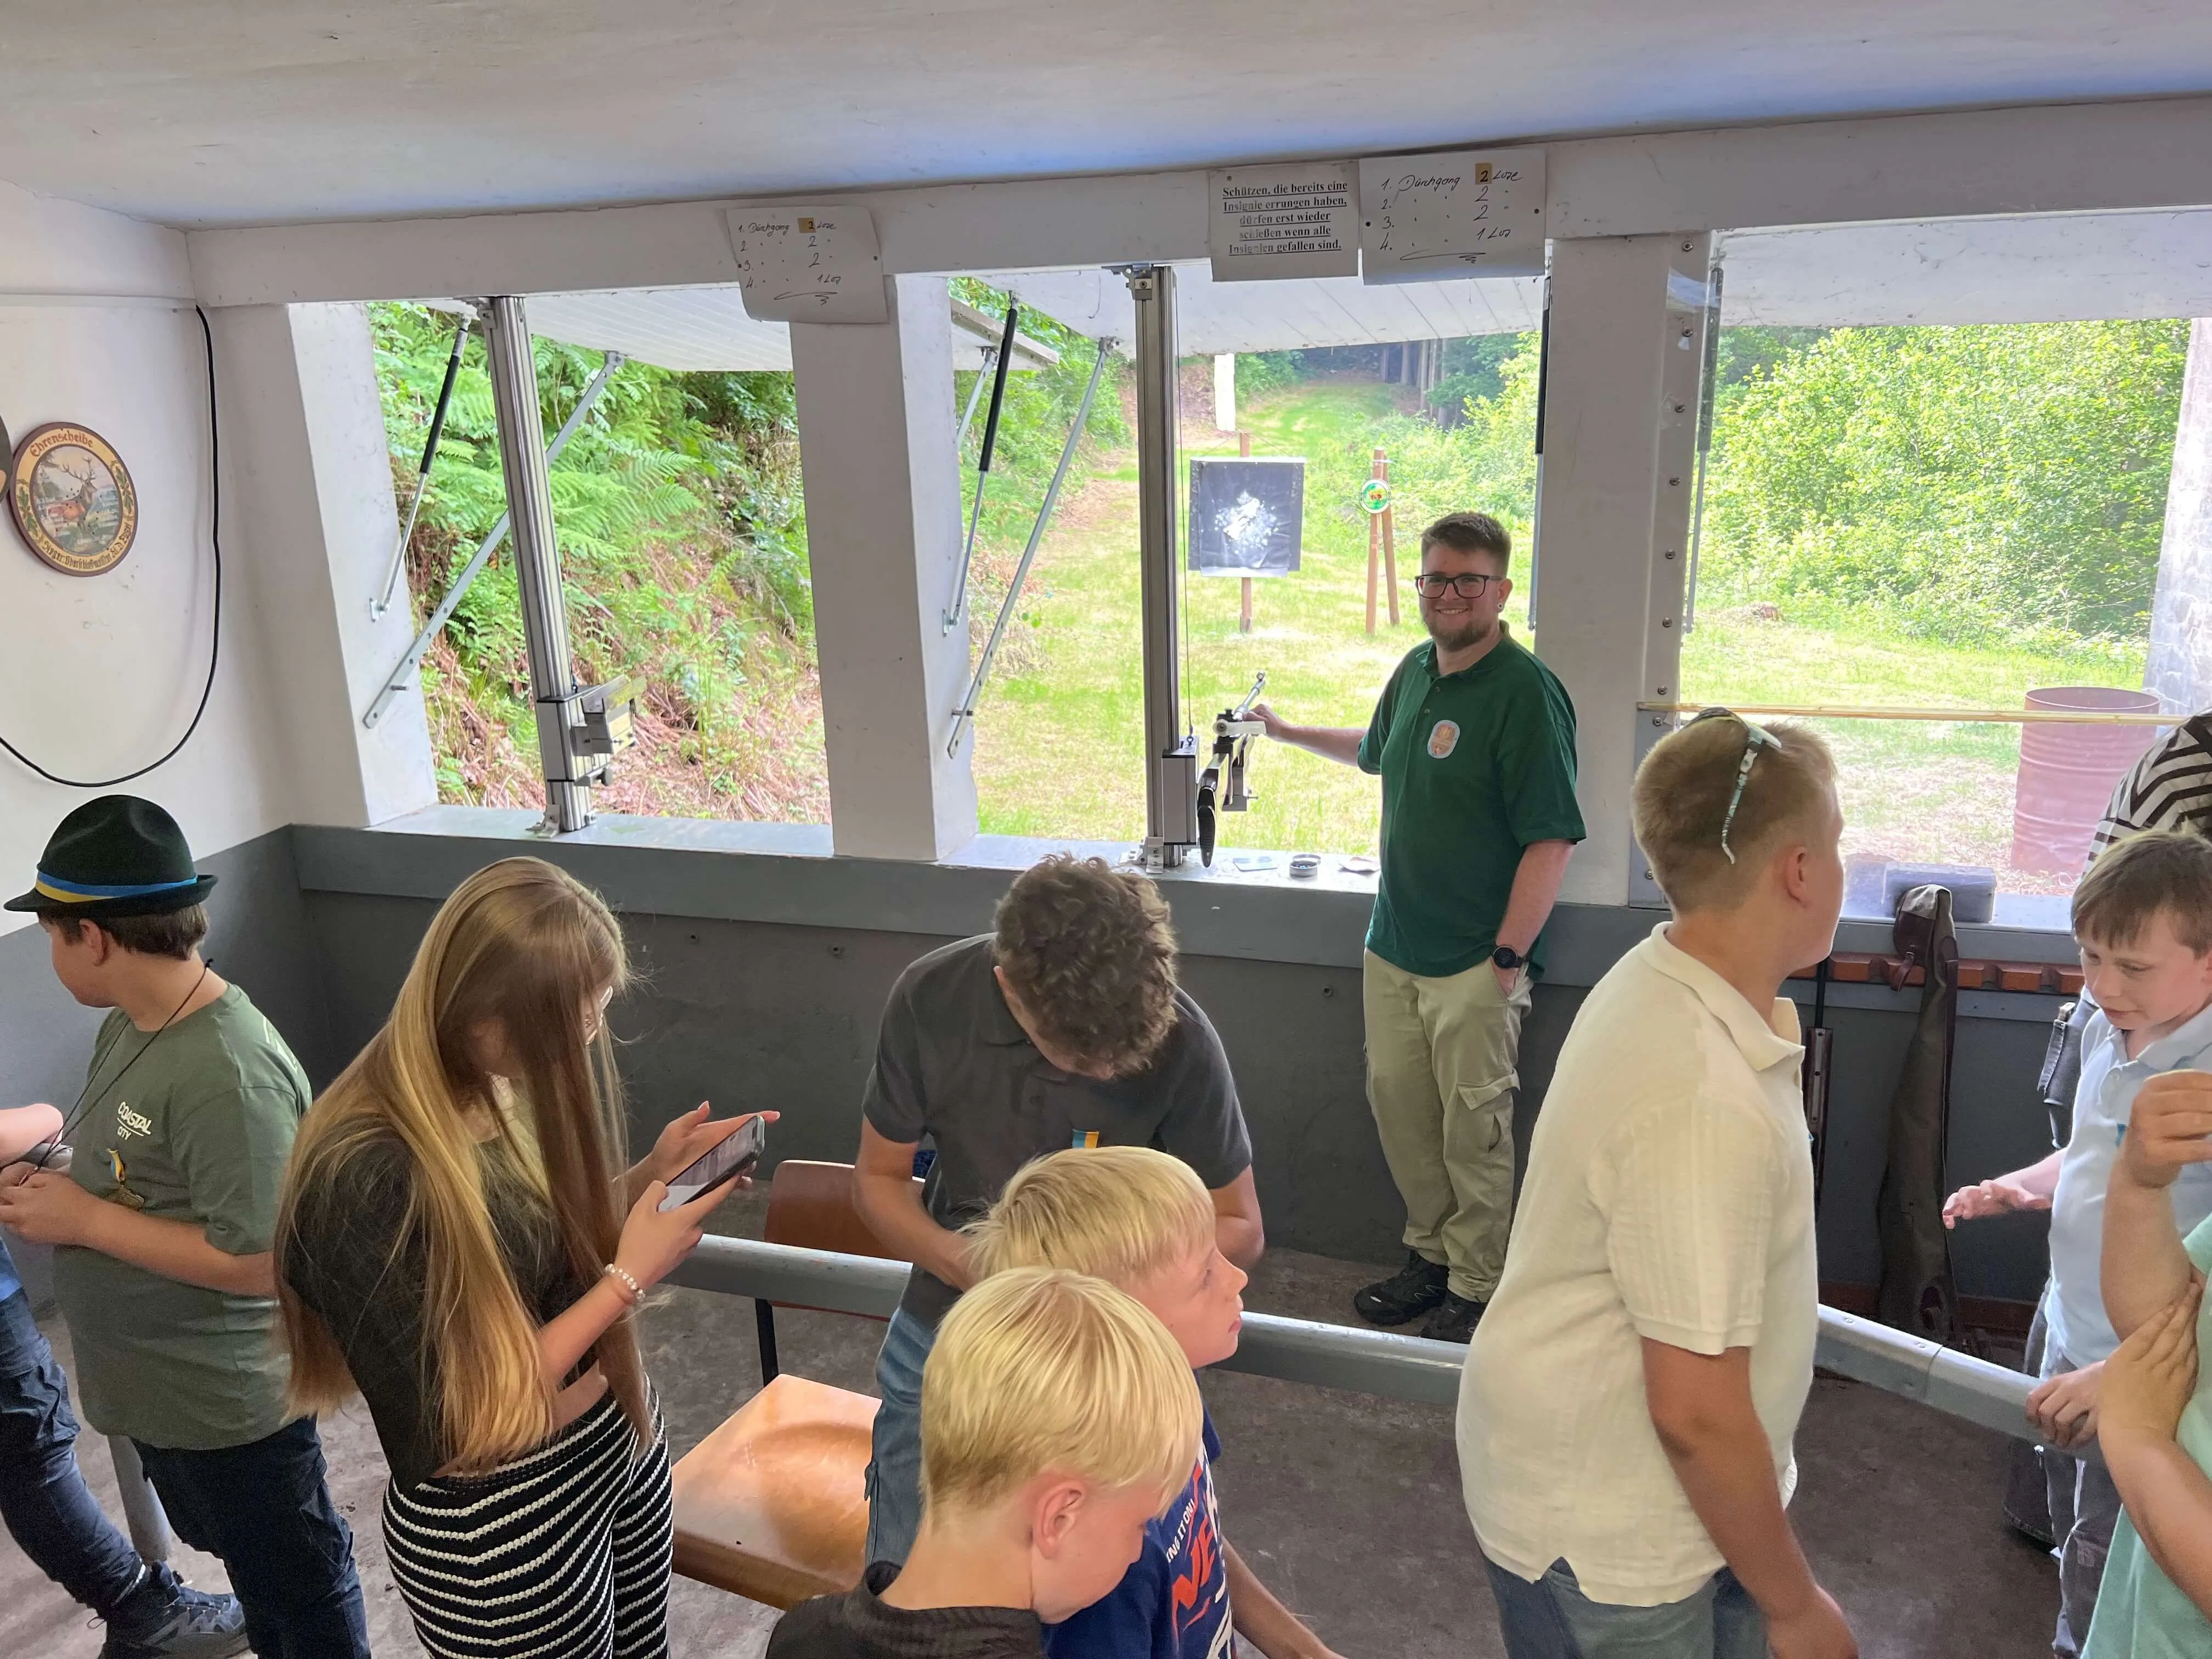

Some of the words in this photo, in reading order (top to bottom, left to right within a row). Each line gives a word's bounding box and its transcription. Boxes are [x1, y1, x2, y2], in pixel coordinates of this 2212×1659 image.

[1381, 178, 1392, 190] 1.
[1480, 170, 1488, 182] 2
[1223, 186, 1271, 197] Schützen,
[1273, 184, 1289, 194] die
[1291, 182, 1325, 193] bereits
[1328, 181, 1347, 191] eine
[1223, 200, 1263, 212] Insignie
[1265, 199, 1311, 208] errungen
[1313, 197, 1347, 207] haben,
[1381, 199, 1391, 210] 2.
[1474, 185, 1488, 202] 2
[808, 221, 815, 229] 2
[1239, 214, 1273, 225] dürfen
[1276, 213, 1294, 223] erst
[1297, 211, 1331, 222] wieder
[1382, 216, 1395, 229] 3.
[1472, 205, 1488, 221] 2
[1239, 228, 1282, 239] schießen
[1313, 225, 1331, 236] alle
[1380, 232, 1392, 250] 4.
[1477, 228, 1485, 240] 1
[808, 235, 818, 248] 2
[1276, 241, 1315, 253] gefallen
[1318, 239, 1342, 250] sind.
[809, 252, 821, 268] 2
[817, 274, 823, 283] 1
[30, 430, 93, 457] Ehrenscheibe
[118, 1101, 152, 1135] COASTAL
[117, 1126, 132, 1140] CITY
[1166, 1536, 1181, 1563] ING
[1178, 1521, 1187, 1541] IT
